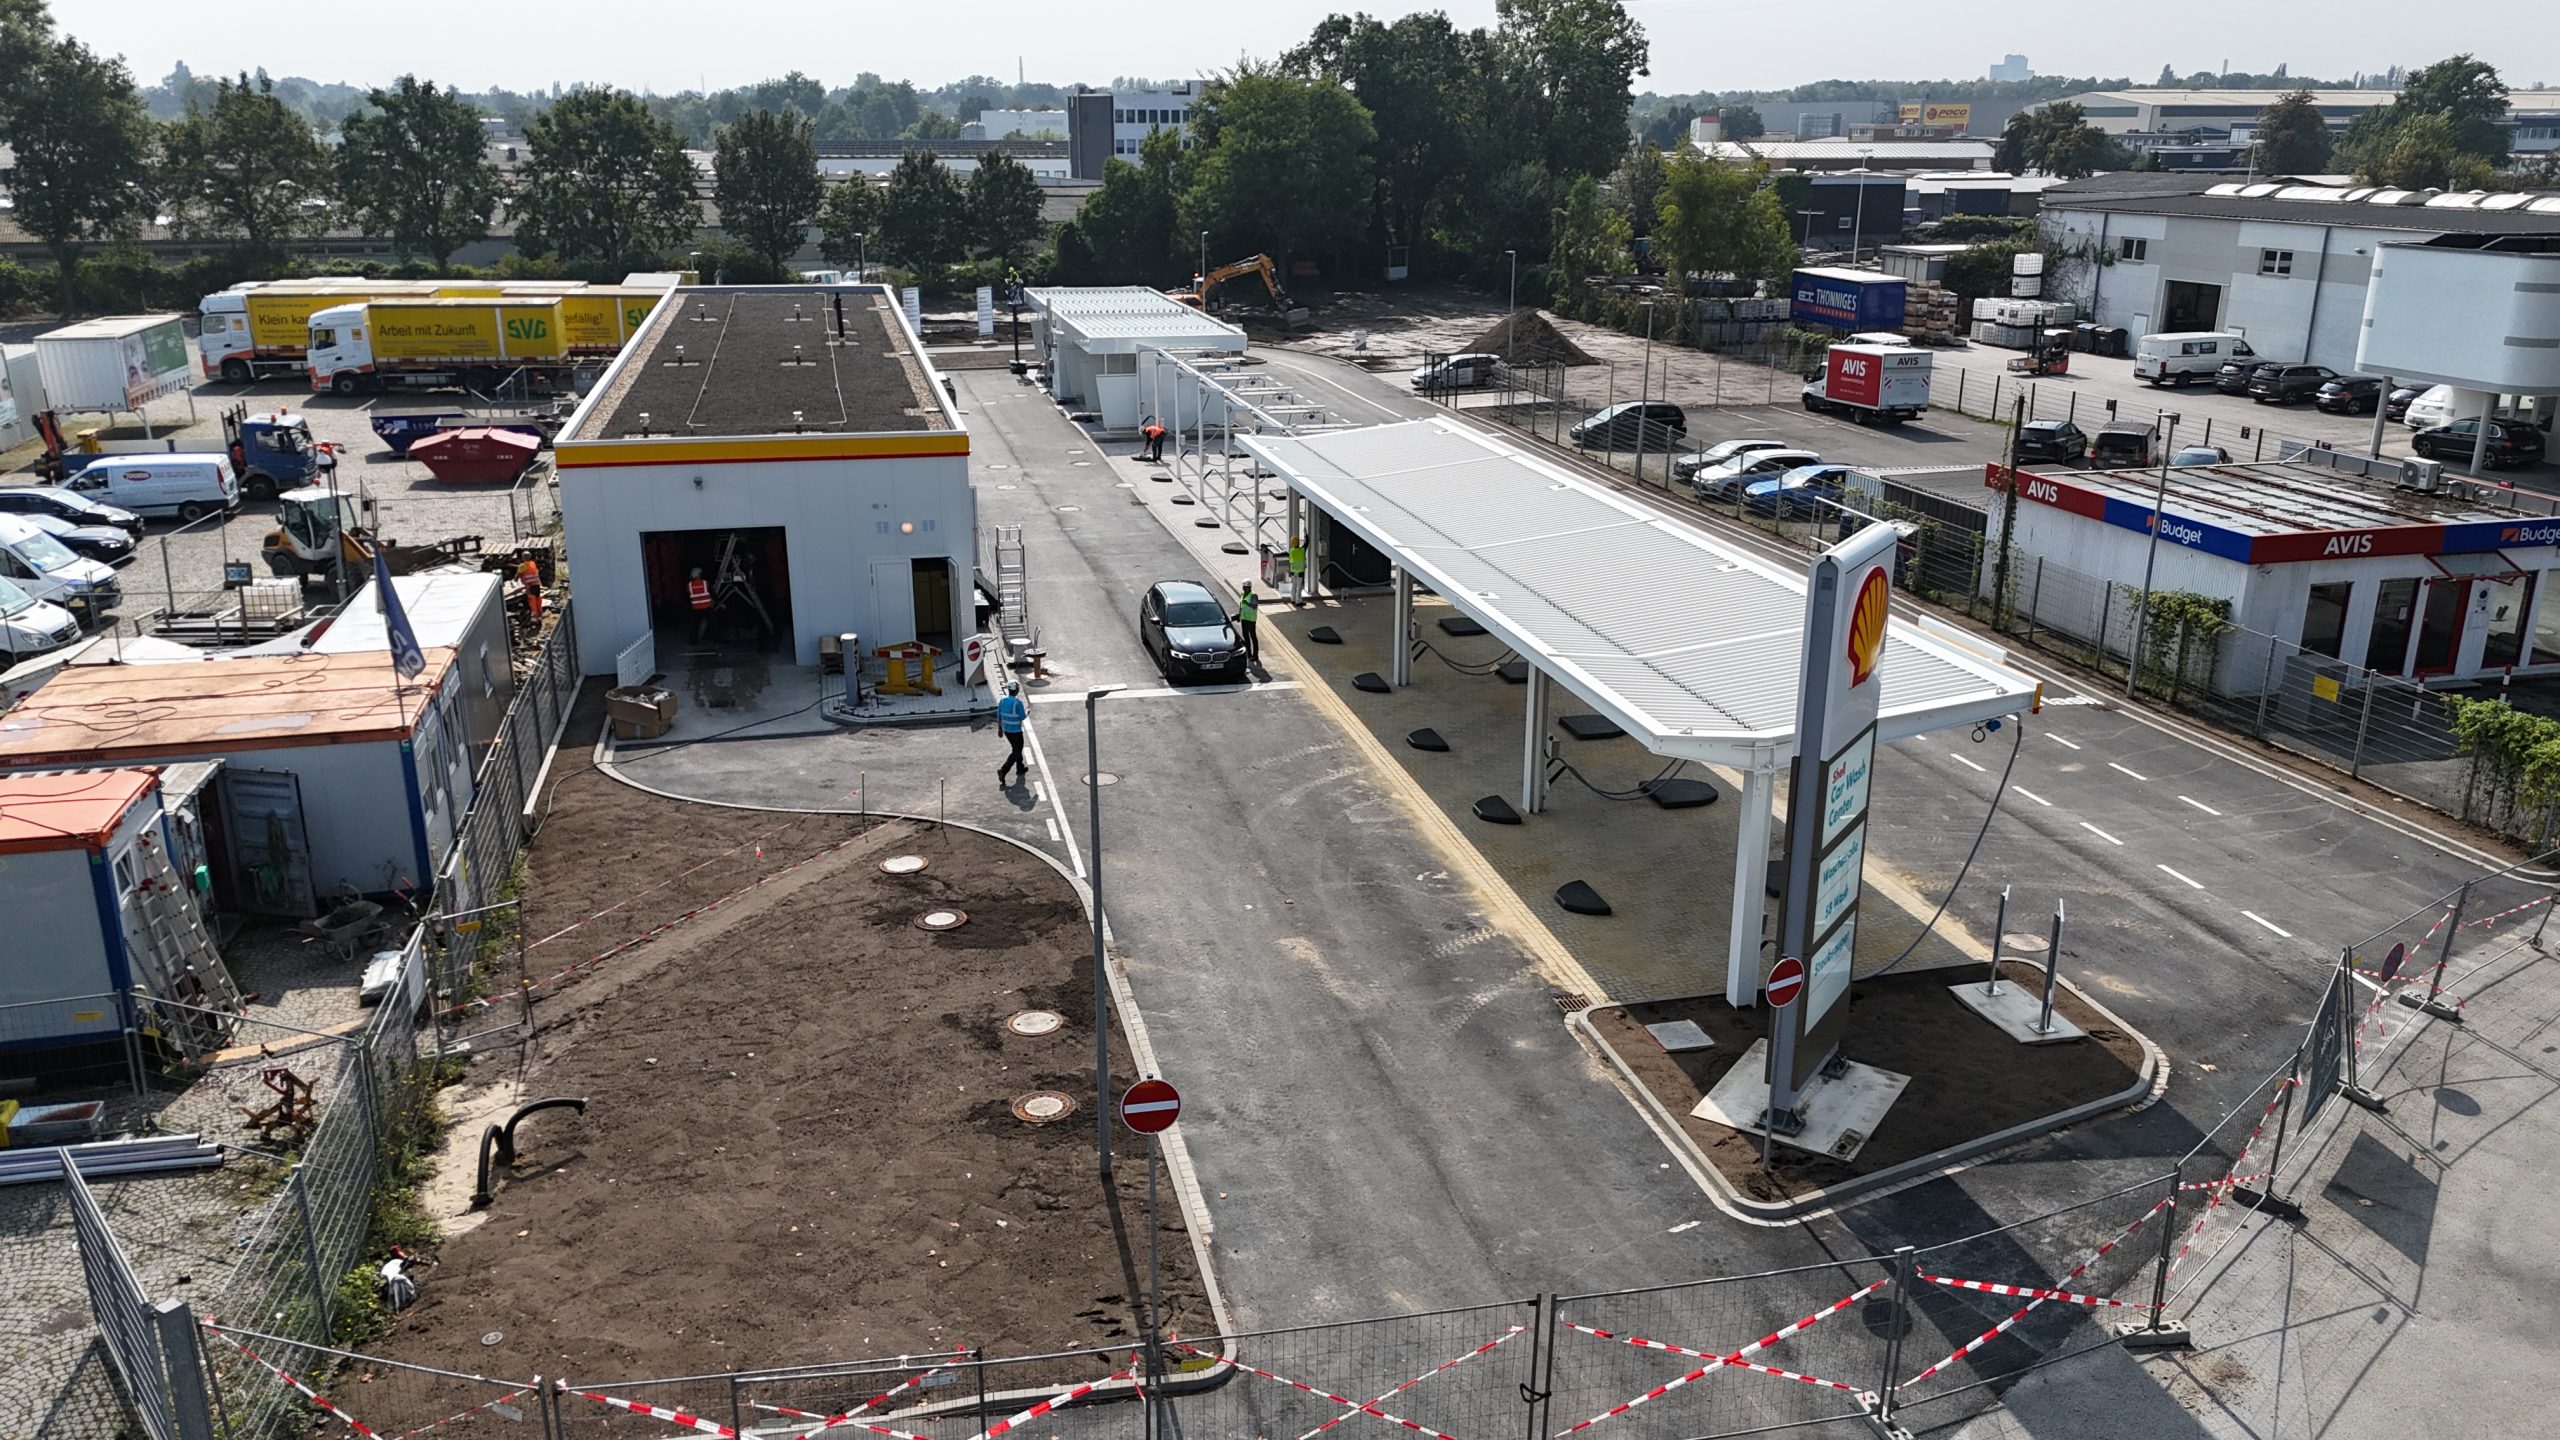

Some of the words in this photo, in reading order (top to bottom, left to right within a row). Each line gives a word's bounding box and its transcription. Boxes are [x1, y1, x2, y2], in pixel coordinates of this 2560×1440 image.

[1938, 109, 1968, 117] POCO
[259, 313, 288, 325] Klein
[379, 325, 412, 337] Arbeit
[415, 324, 432, 336] mit
[434, 323, 477, 336] Zukunft
[507, 318, 547, 340] SVG
[1841, 358, 1867, 377] AVIS
[1897, 357, 1919, 366] AVIS
[2027, 479, 2058, 503] AVIS
[2161, 519, 2202, 545] Budget
[2323, 533, 2373, 555] AVIS
[1831, 783, 1844, 804] Car
[1846, 758, 1866, 790] Wash
[1829, 795, 1854, 827] Center
